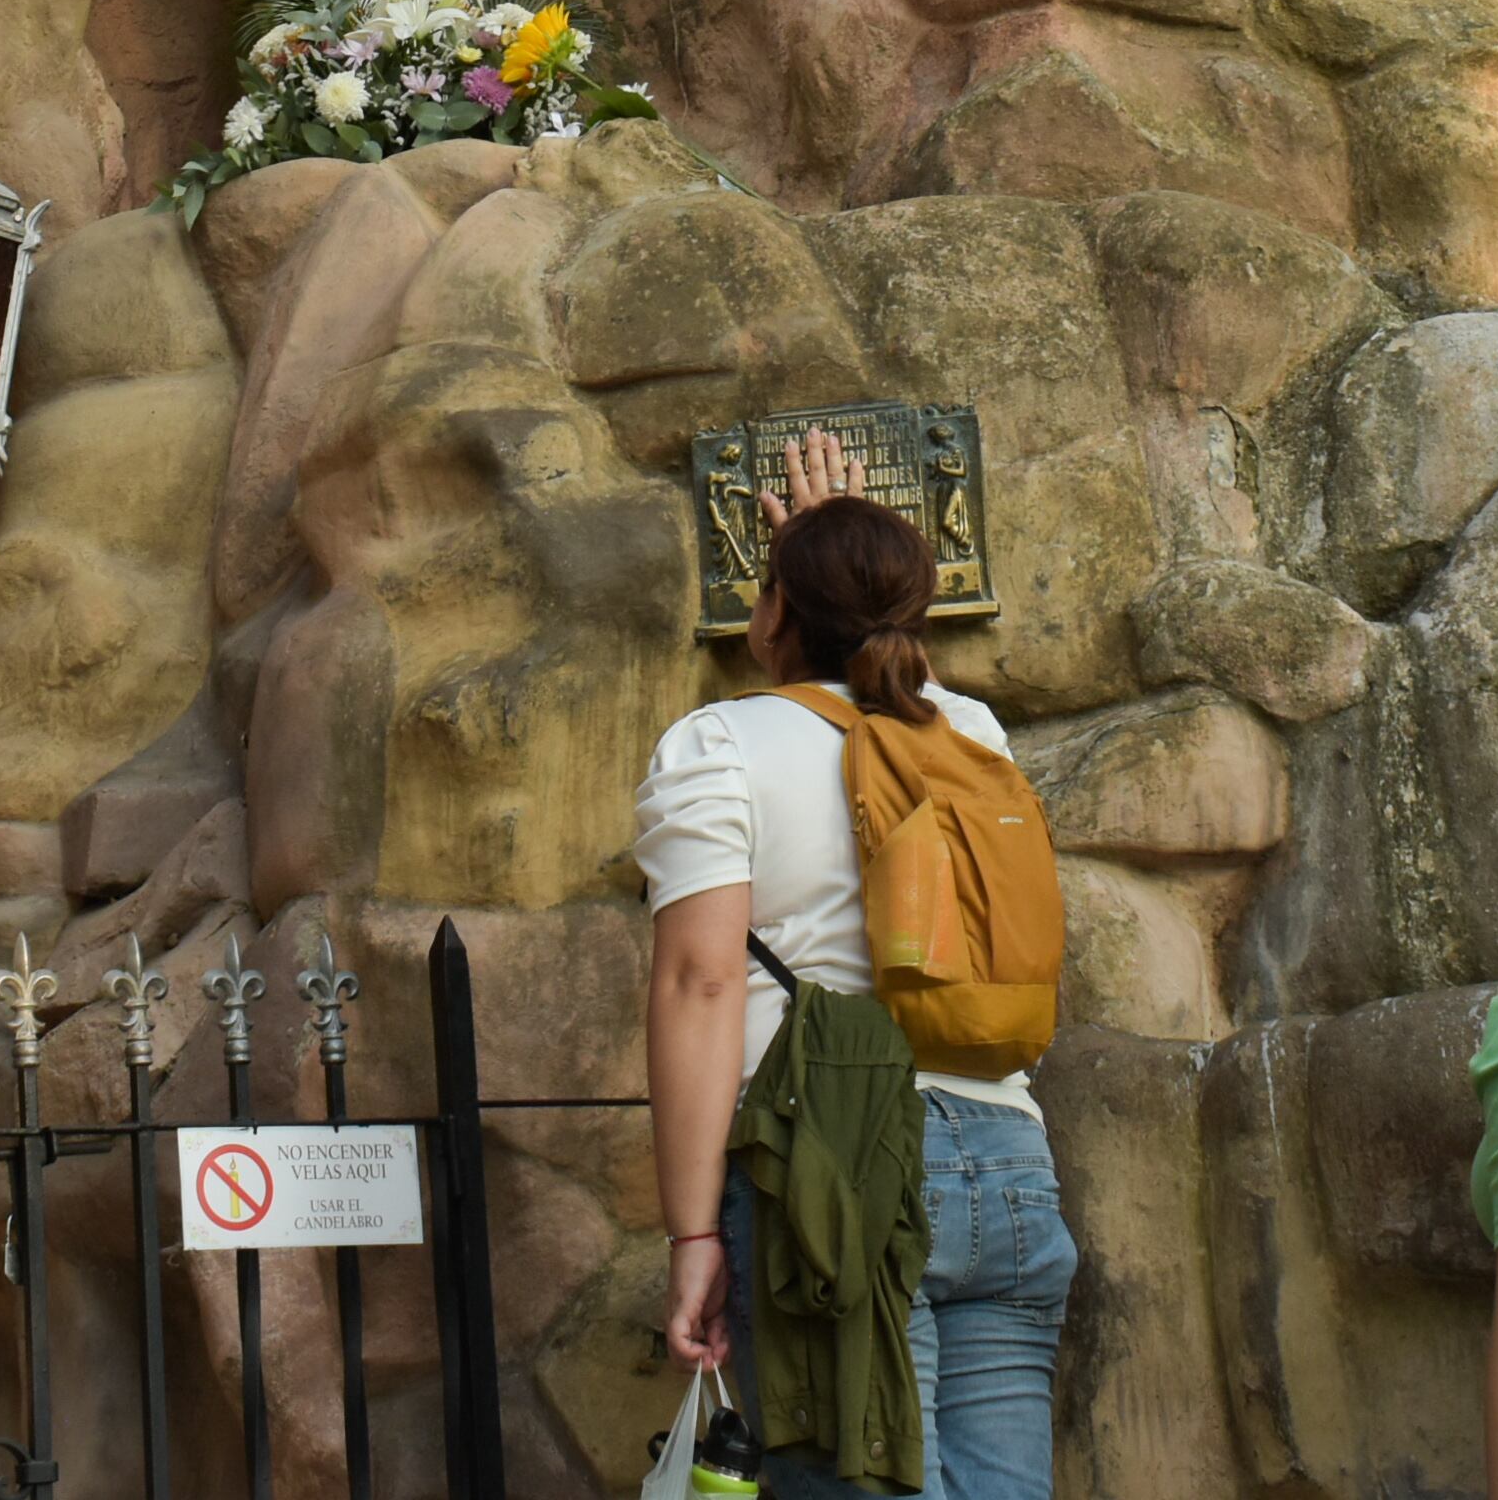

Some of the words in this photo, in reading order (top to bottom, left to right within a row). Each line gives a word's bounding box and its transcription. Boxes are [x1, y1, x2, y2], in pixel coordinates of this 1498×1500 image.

[827, 413, 877, 428] FEBRERO
[841, 427, 867, 448] ALTA
[875, 446, 891, 465] DE
[277, 1144, 302, 1160] NO
[307, 1143, 394, 1160] ENCENDER
[291, 1163, 342, 1180] VELAS
[346, 1163, 386, 1183] AQUI
[309, 1199, 345, 1213] USAR
[348, 1198, 364, 1212] EL
[294, 1215, 384, 1230] CANDELABRO
